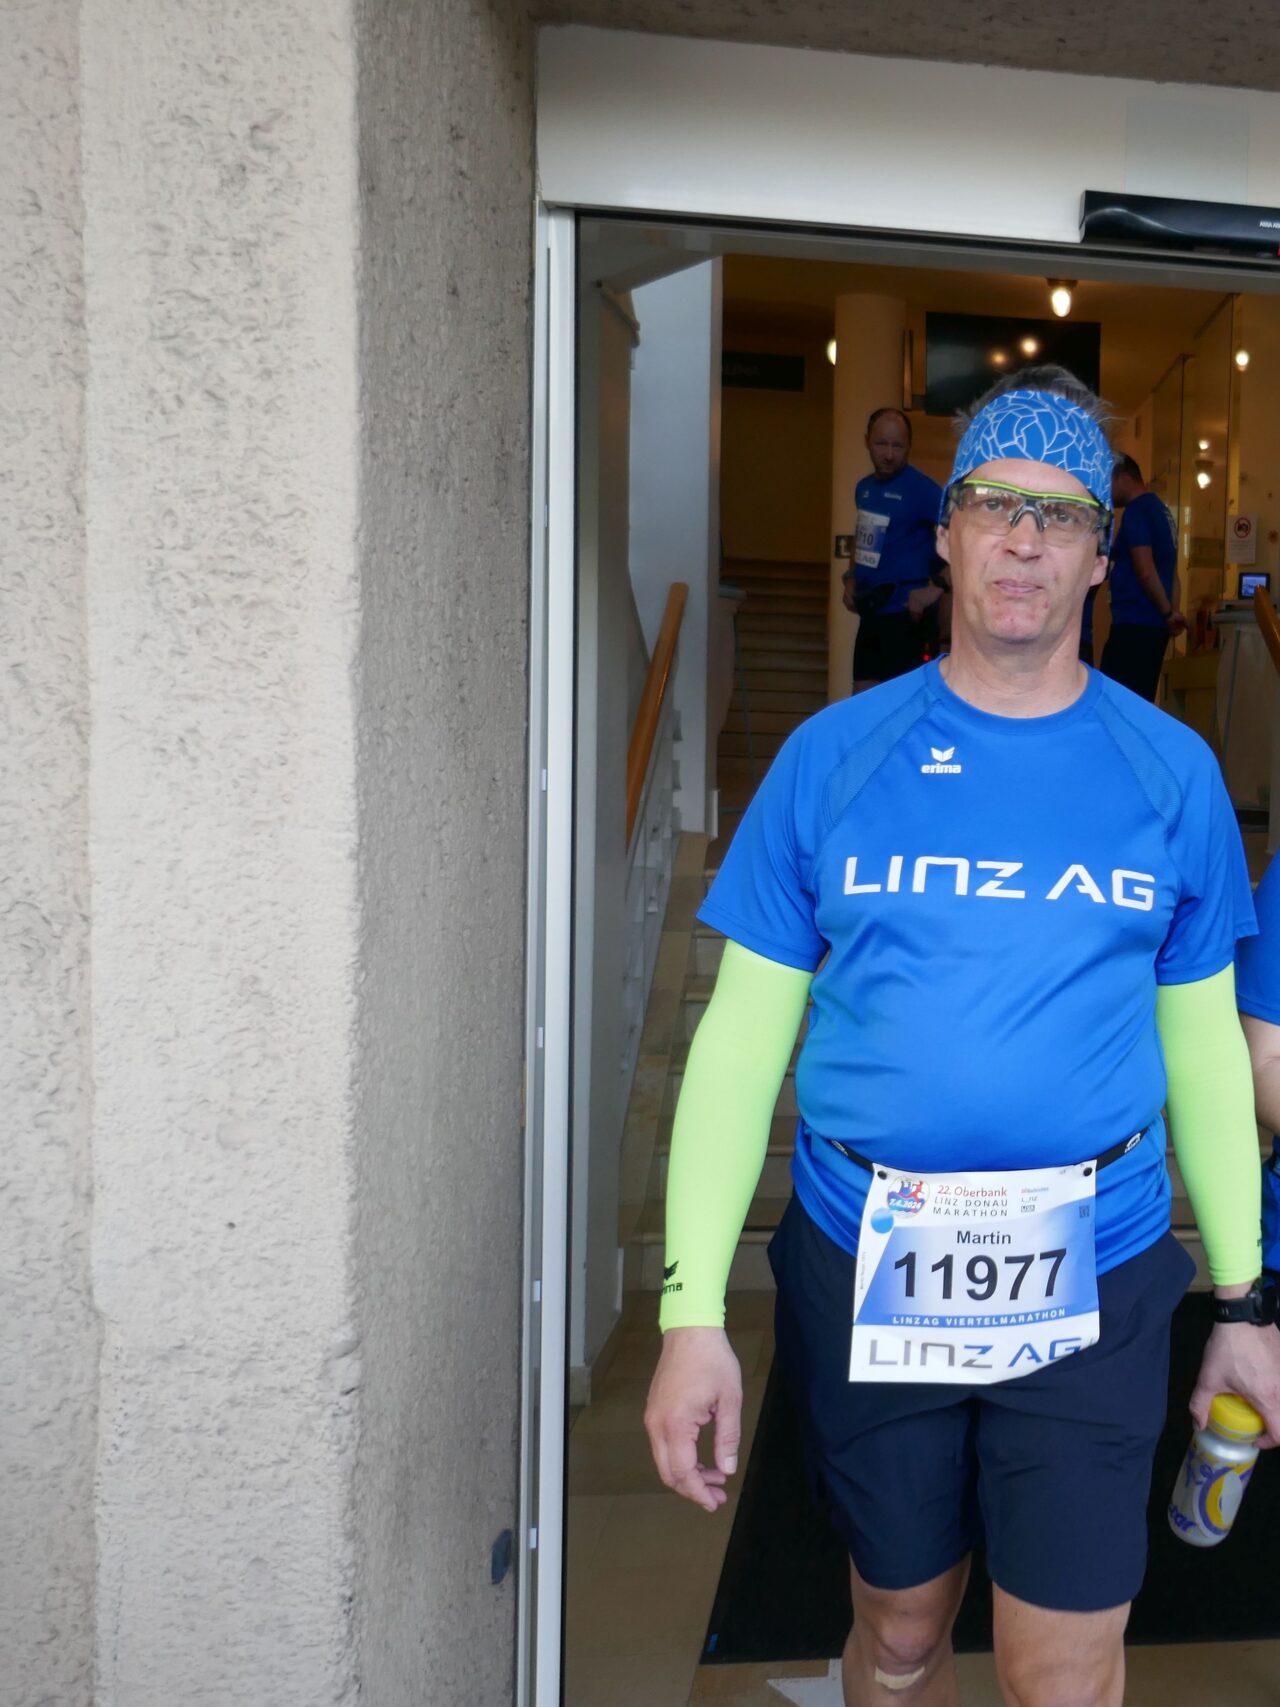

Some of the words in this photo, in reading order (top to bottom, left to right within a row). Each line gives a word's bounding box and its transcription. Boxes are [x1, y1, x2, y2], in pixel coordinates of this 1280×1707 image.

[921, 762, 961, 774] erima
[843, 855, 1025, 899] LINZ
[1045, 863, 1156, 912] AG
[954, 1185, 1008, 1197] Oberbank
[934, 1196, 958, 1206] LINZ
[965, 1198, 1008, 1207] DONAU
[933, 1207, 1008, 1217] MARATHON
[956, 1230, 1012, 1245] Martin
[894, 1248, 1067, 1301] 11977
[945, 1308, 1066, 1326] VIERTELMARATHON
[869, 1339, 993, 1369] LINZ
[1008, 1337, 1082, 1367] AG
